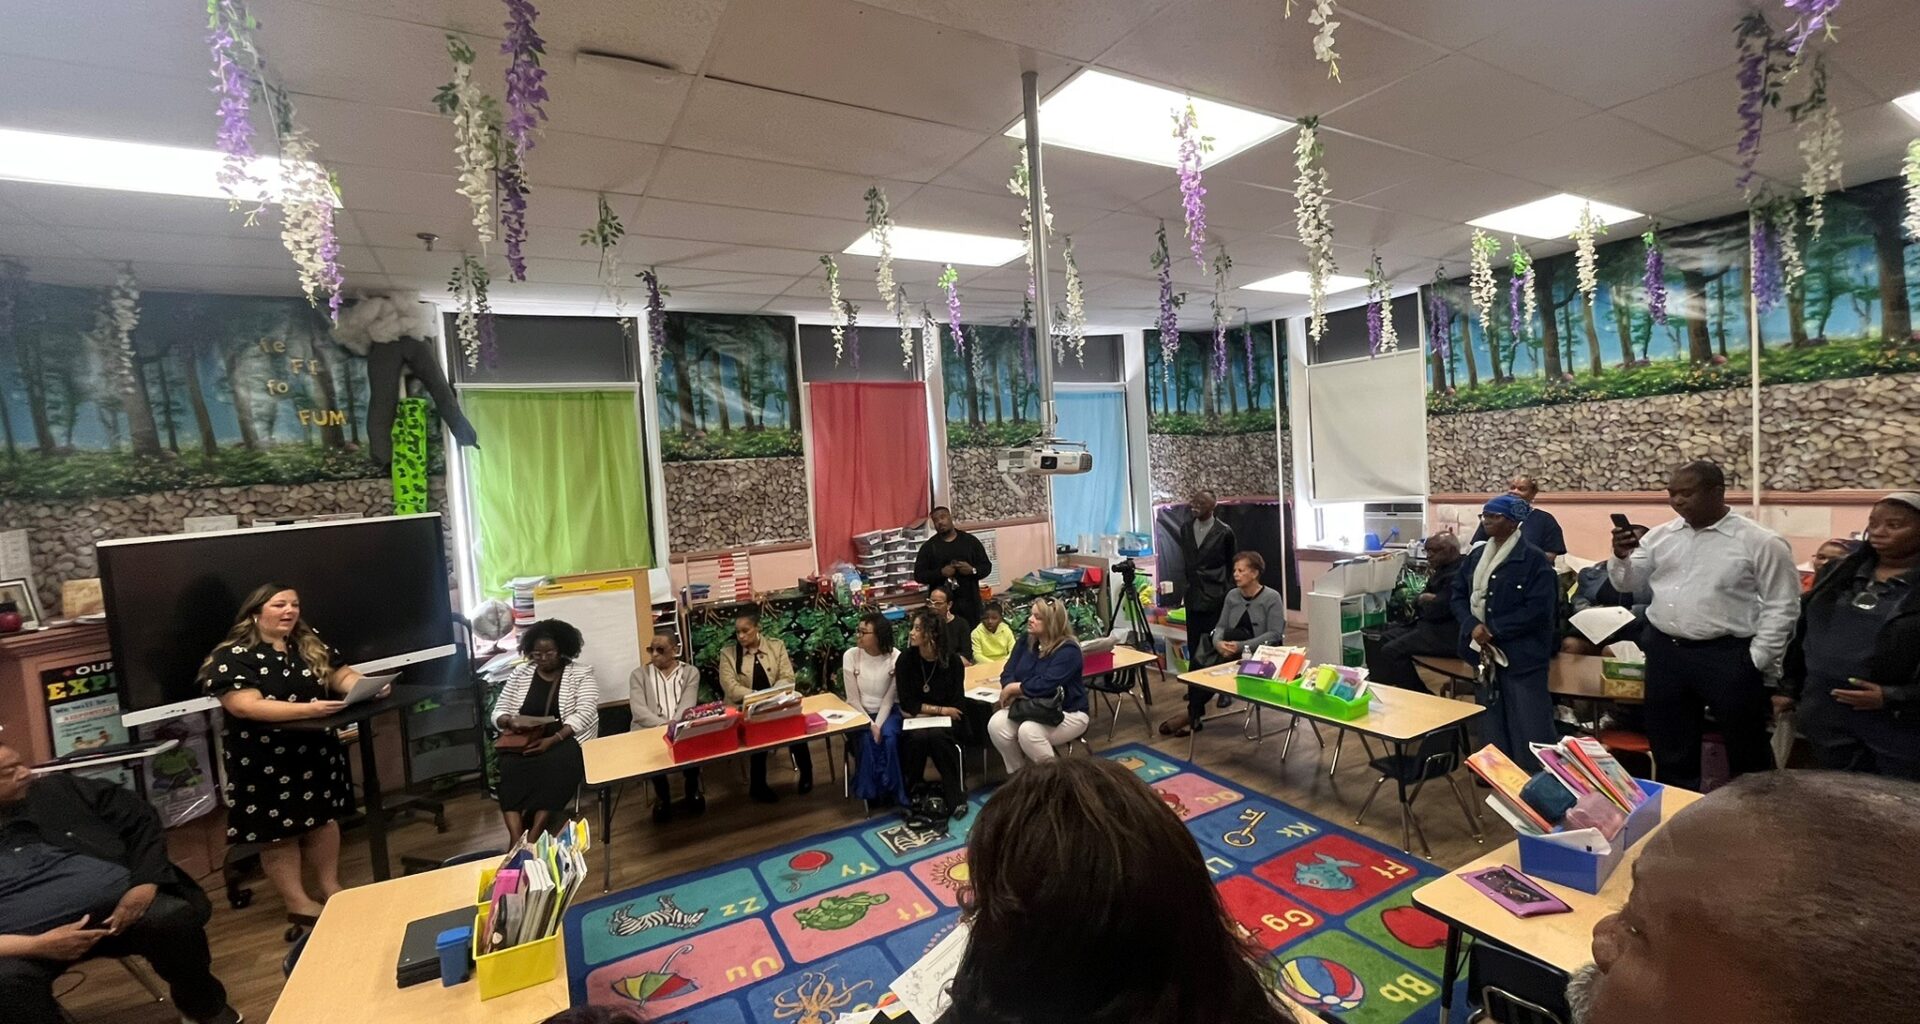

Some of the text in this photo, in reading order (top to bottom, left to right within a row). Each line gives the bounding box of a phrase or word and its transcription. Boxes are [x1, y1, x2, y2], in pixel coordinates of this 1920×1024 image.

[299, 409, 347, 426] FUM
[1276, 821, 1318, 838] Kk
[841, 861, 876, 877] Yy
[1371, 859, 1409, 880] Ff
[720, 896, 761, 917] Zz
[896, 902, 932, 920] Tt
[1261, 909, 1315, 932] Gg
[725, 956, 779, 983] Uu
[1379, 973, 1435, 1003] Bb
